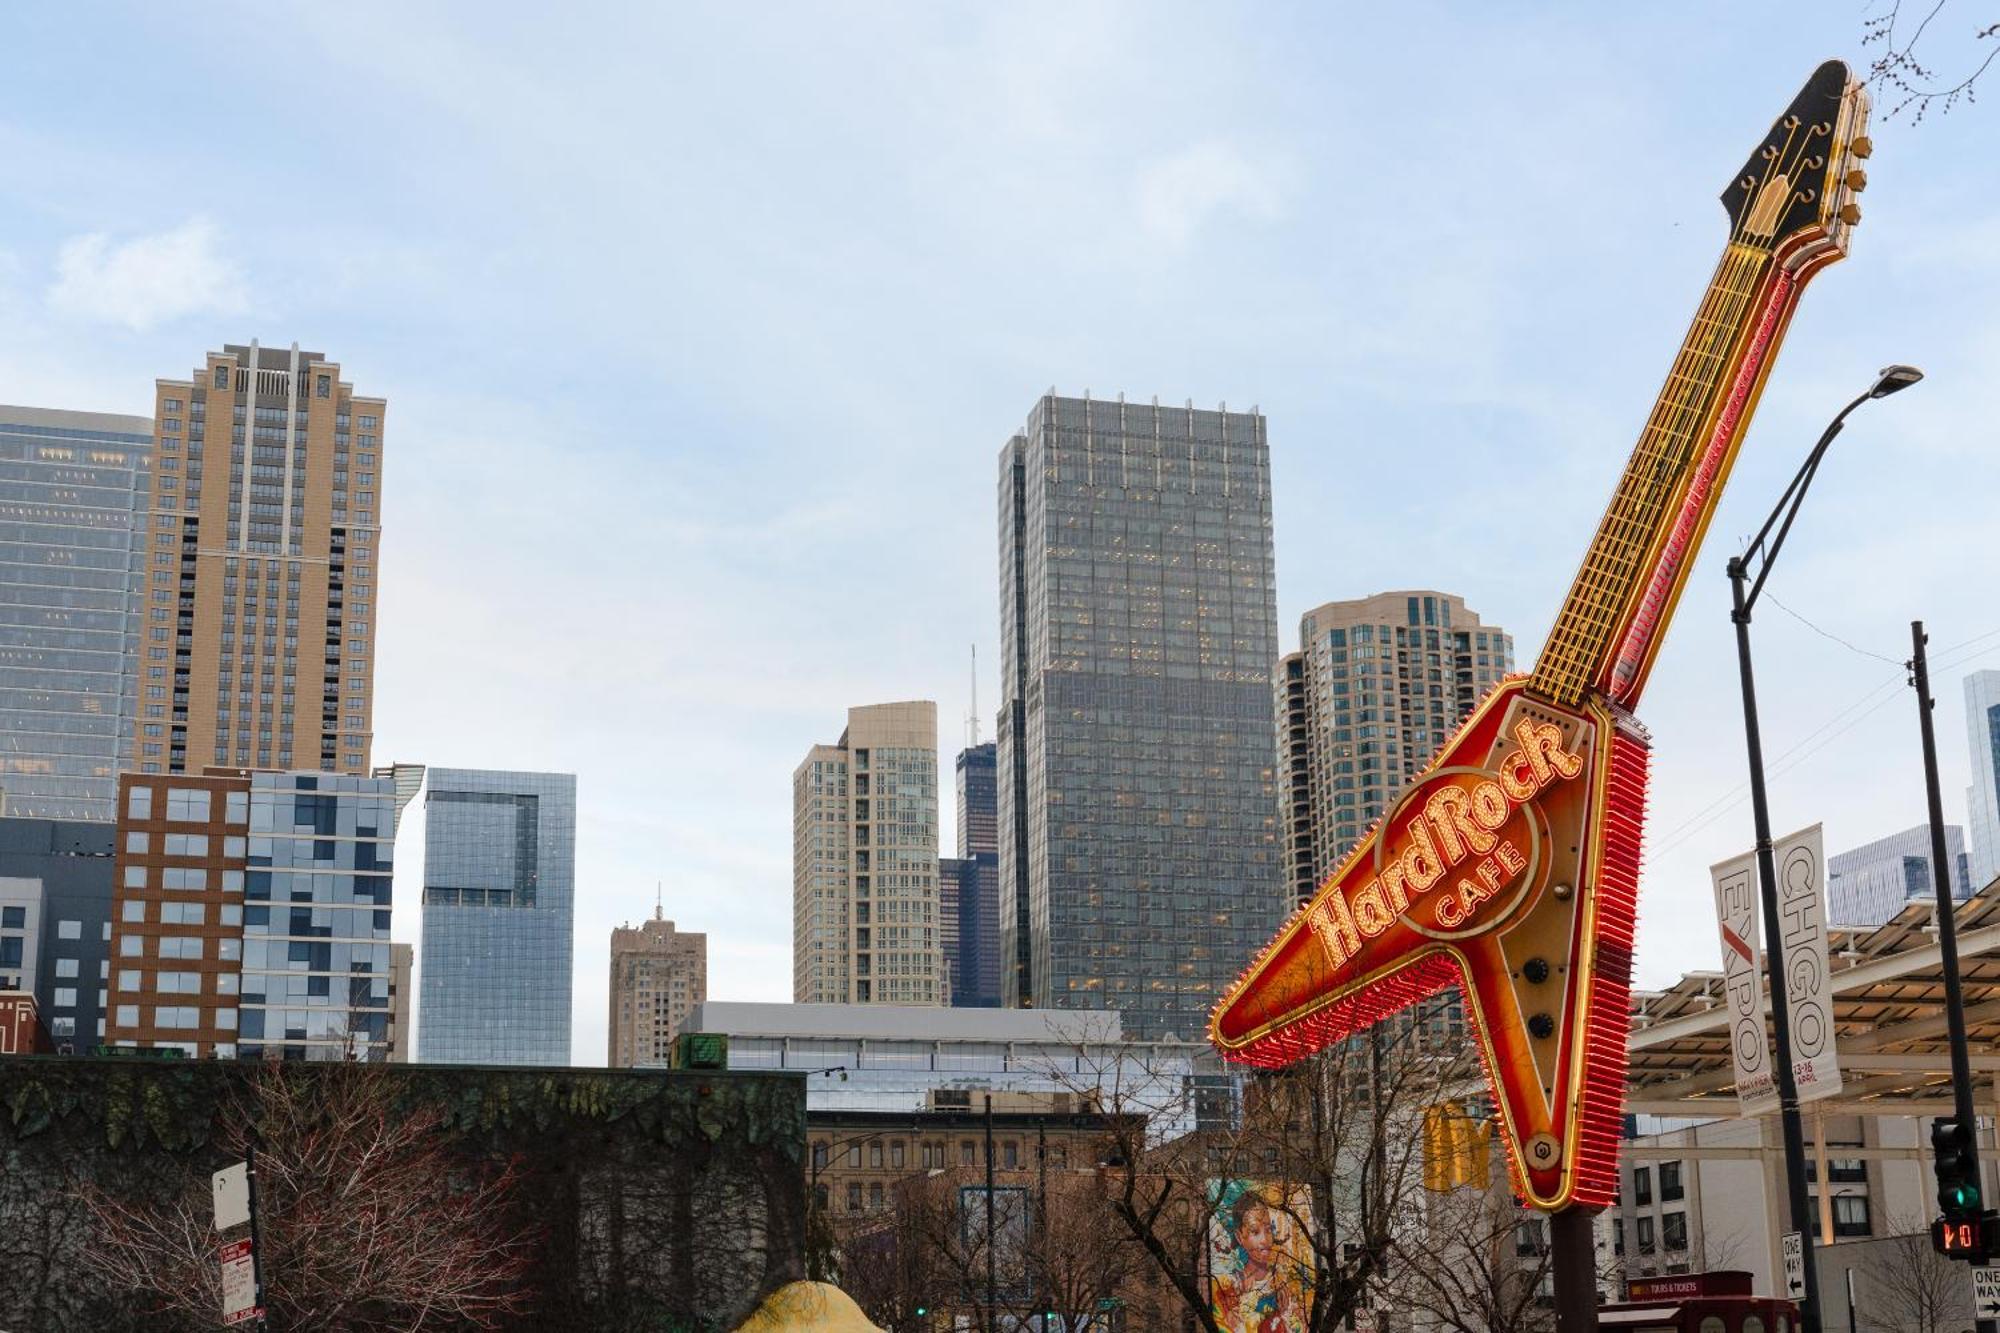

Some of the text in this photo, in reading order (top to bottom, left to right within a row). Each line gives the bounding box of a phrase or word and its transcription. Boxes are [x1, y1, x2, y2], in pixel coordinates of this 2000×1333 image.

[1308, 716, 1583, 971] Hard Rock
[1435, 840, 1527, 928] CAFE
[1718, 868, 1763, 1073] EXPO
[1780, 845, 1827, 1059] CHGO
[1785, 1239, 1801, 1256] ONE
[1786, 1257, 1801, 1274] WAY
[1975, 1271, 2000, 1283] ONE
[1976, 1285, 2000, 1298] WAY
